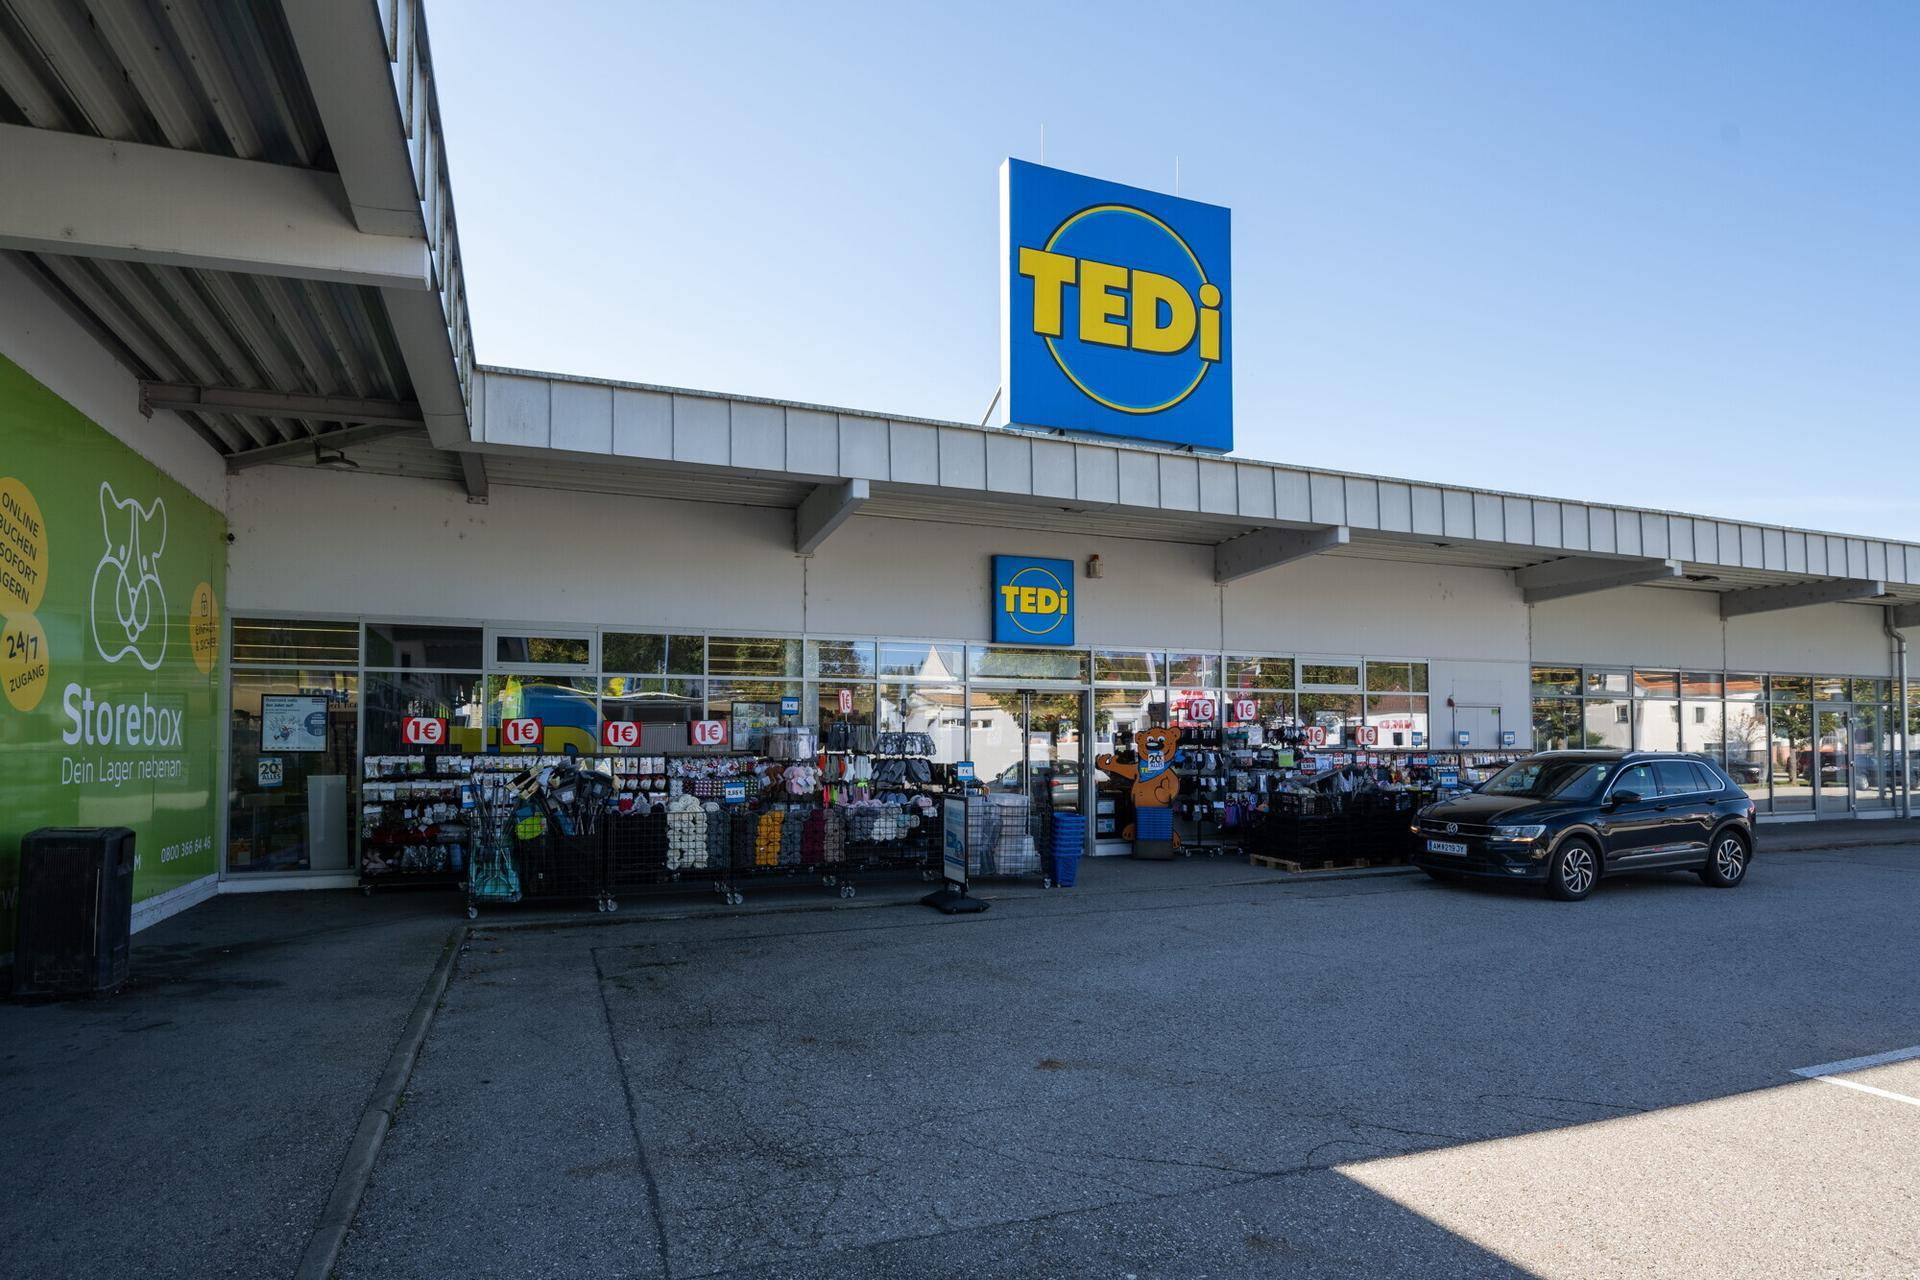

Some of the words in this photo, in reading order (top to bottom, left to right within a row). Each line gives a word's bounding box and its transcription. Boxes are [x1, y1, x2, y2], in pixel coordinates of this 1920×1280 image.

[1019, 246, 1221, 362] TEDi
[2, 493, 39, 538] ONLINE
[0, 541, 38, 585] SOFORT
[1001, 585, 1068, 615] TEDi
[6, 631, 38, 664] 24/7
[9, 664, 45, 692] ZUGANG
[62, 682, 182, 746] Storebox
[1193, 702, 1210, 718] 1€
[1239, 702, 1252, 718] 1€
[413, 720, 437, 740] 1€
[512, 722, 534, 741] 1€
[612, 724, 633, 742] 1€
[699, 724, 719, 741] 1€
[1309, 729, 1322, 742] 1€
[1360, 729, 1374, 742] 1€
[62, 753, 94, 785] Dein
[97, 756, 134, 788] Lager
[138, 754, 181, 780] nebenan
[161, 845, 180, 863] 0800
